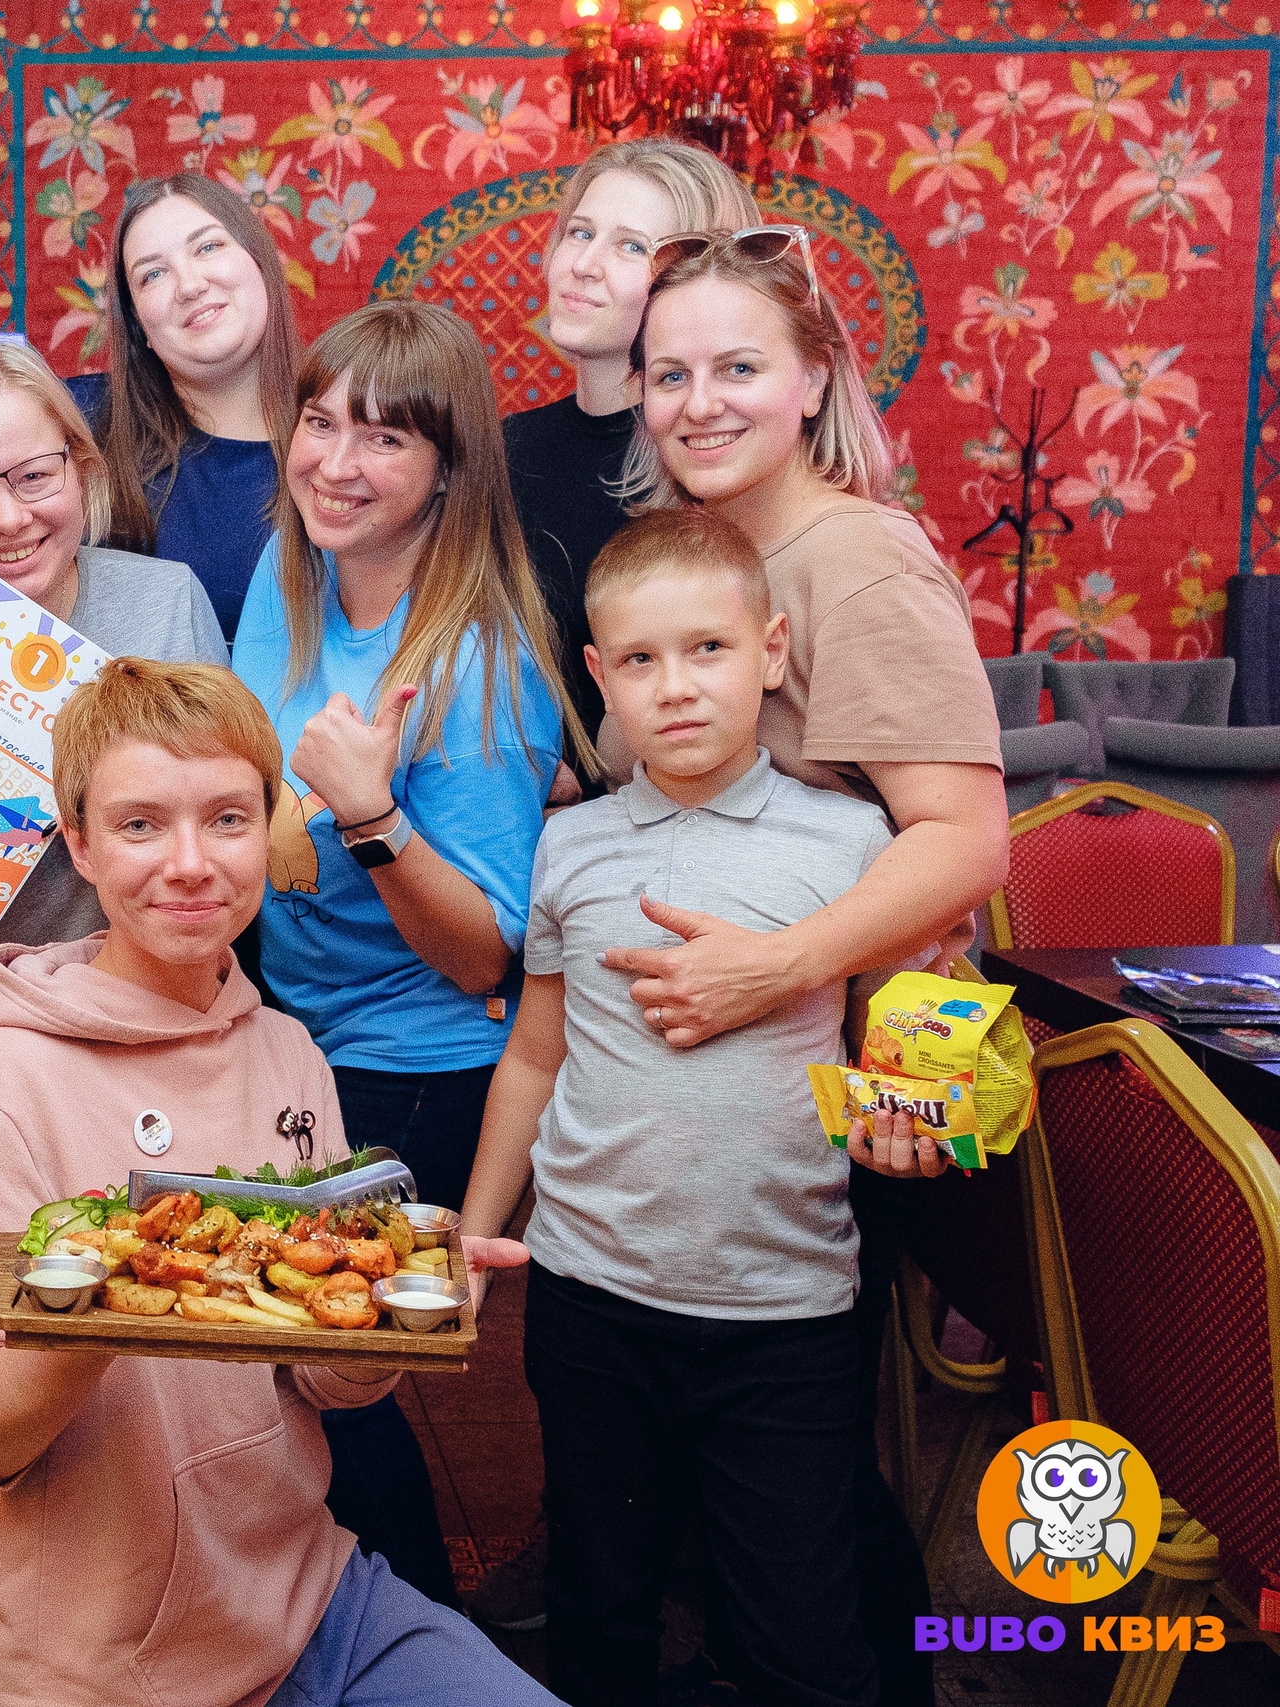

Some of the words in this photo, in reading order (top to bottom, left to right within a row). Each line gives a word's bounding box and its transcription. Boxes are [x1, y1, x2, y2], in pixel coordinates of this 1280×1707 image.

[29, 649, 49, 677] 1
[918, 1050, 931, 1059] MINI
[918, 1056, 956, 1070] CROISSANTS
